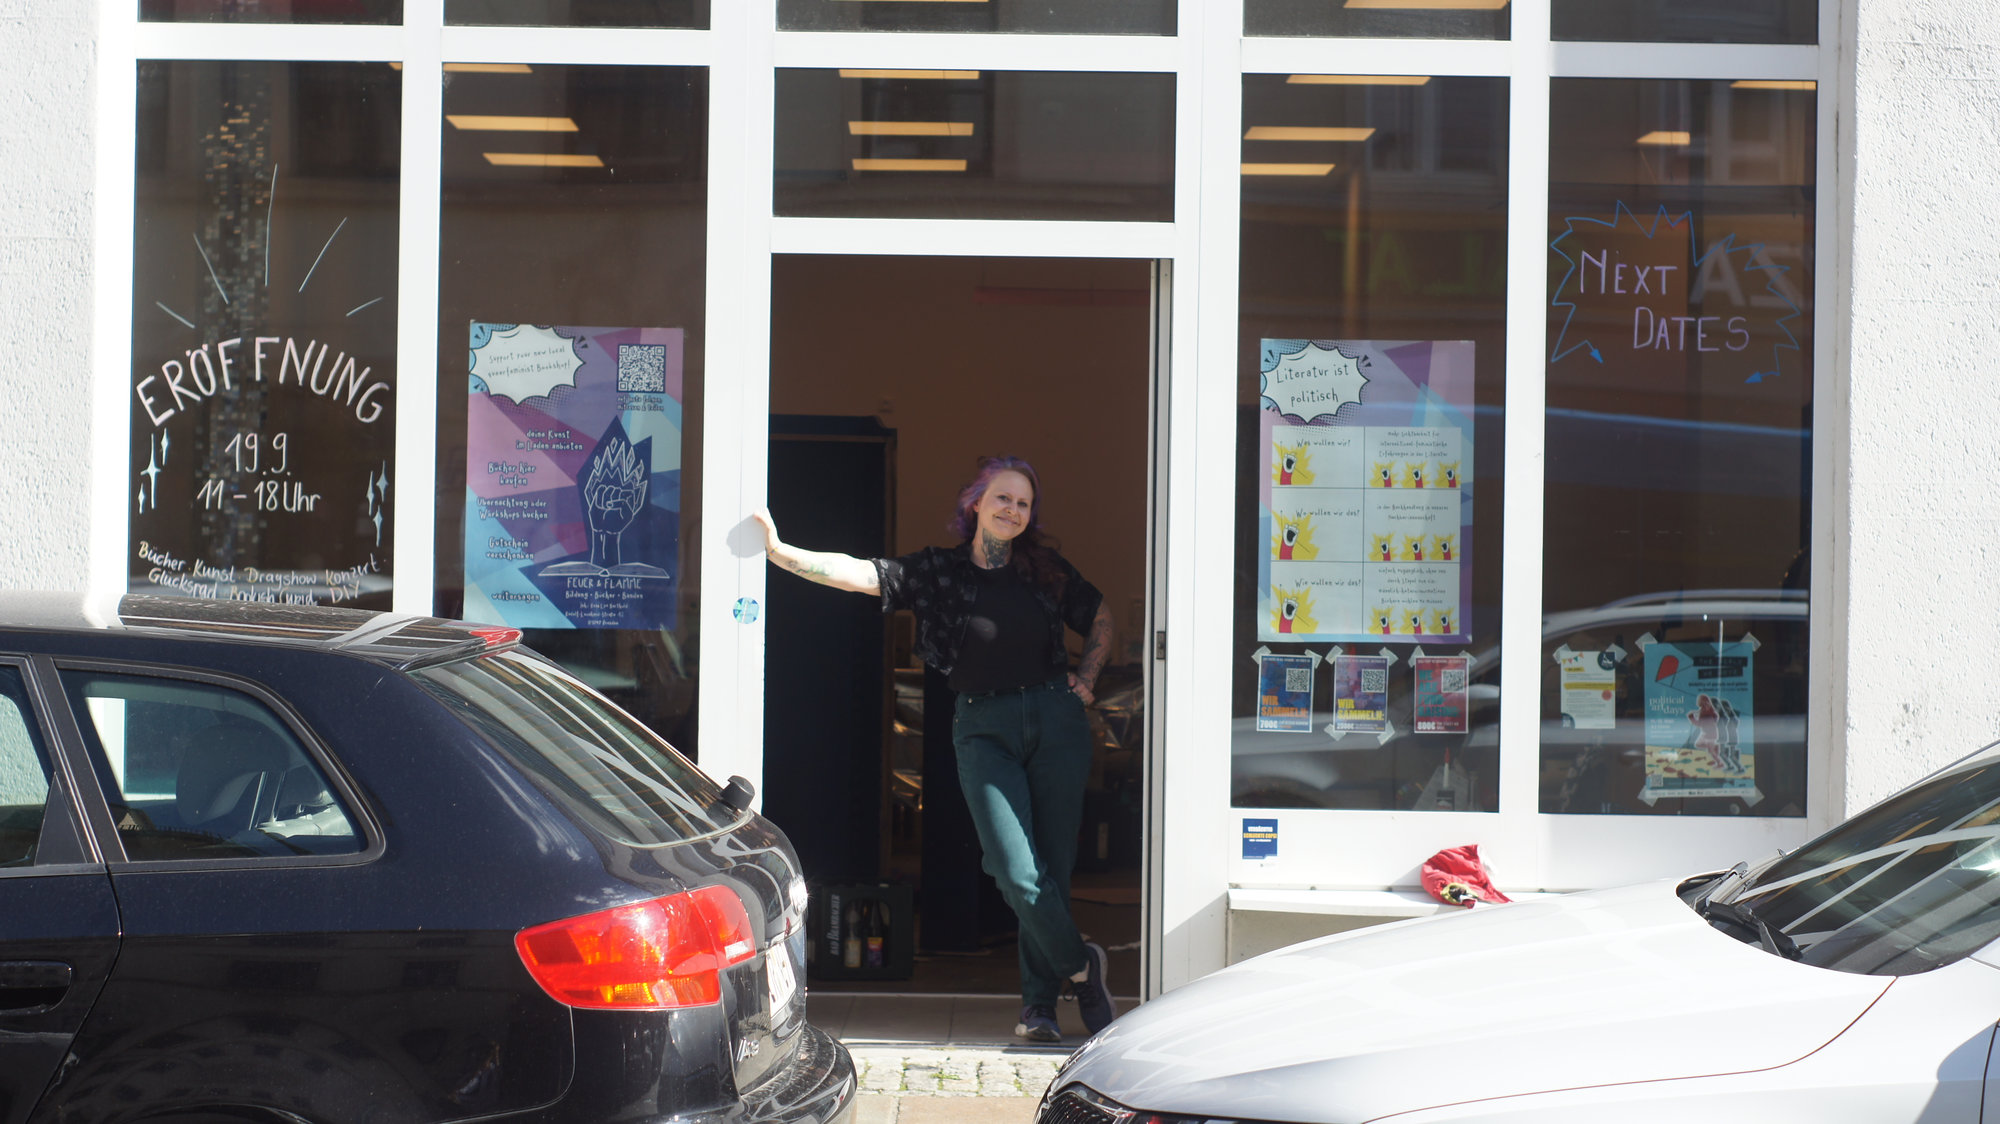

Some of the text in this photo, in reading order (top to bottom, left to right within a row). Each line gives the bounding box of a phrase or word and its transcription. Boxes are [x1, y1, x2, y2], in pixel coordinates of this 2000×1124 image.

[1580, 249, 1678, 295] NEXT
[1633, 306, 1750, 352] DATES
[1276, 363, 1349, 384] Literatur ist
[136, 337, 390, 427] ERÖFFNUNG
[1290, 387, 1339, 407] politisch
[526, 429, 570, 440] deine Kunst
[516, 440, 583, 451] im Laden anbieten
[1313, 439, 1335, 447] wollen
[488, 462, 536, 476] Bücher hier
[499, 475, 528, 488] kaufen
[530, 499, 547, 507] oder
[479, 508, 548, 520] Workshops buchen
[1309, 509, 1331, 517] wollen
[488, 537, 529, 549] Gutschein
[486, 550, 534, 560] verschenken
[138, 540, 380, 591] Bücher Kunst Dragshow Konzert
[148, 567, 218, 600] Glücksrad
[331, 580, 360, 604] DIY
[567, 577, 594, 589] FEUER
[604, 577, 642, 590] FLAMME
[1311, 579, 1333, 587] wollen
[491, 591, 541, 603] weitersagen
[565, 590, 589, 600] Bildung
[1262, 695, 1279, 706] WIR
[1337, 698, 1355, 709] WIR
[1649, 696, 1684, 706] political
[1663, 705, 1685, 716] days
